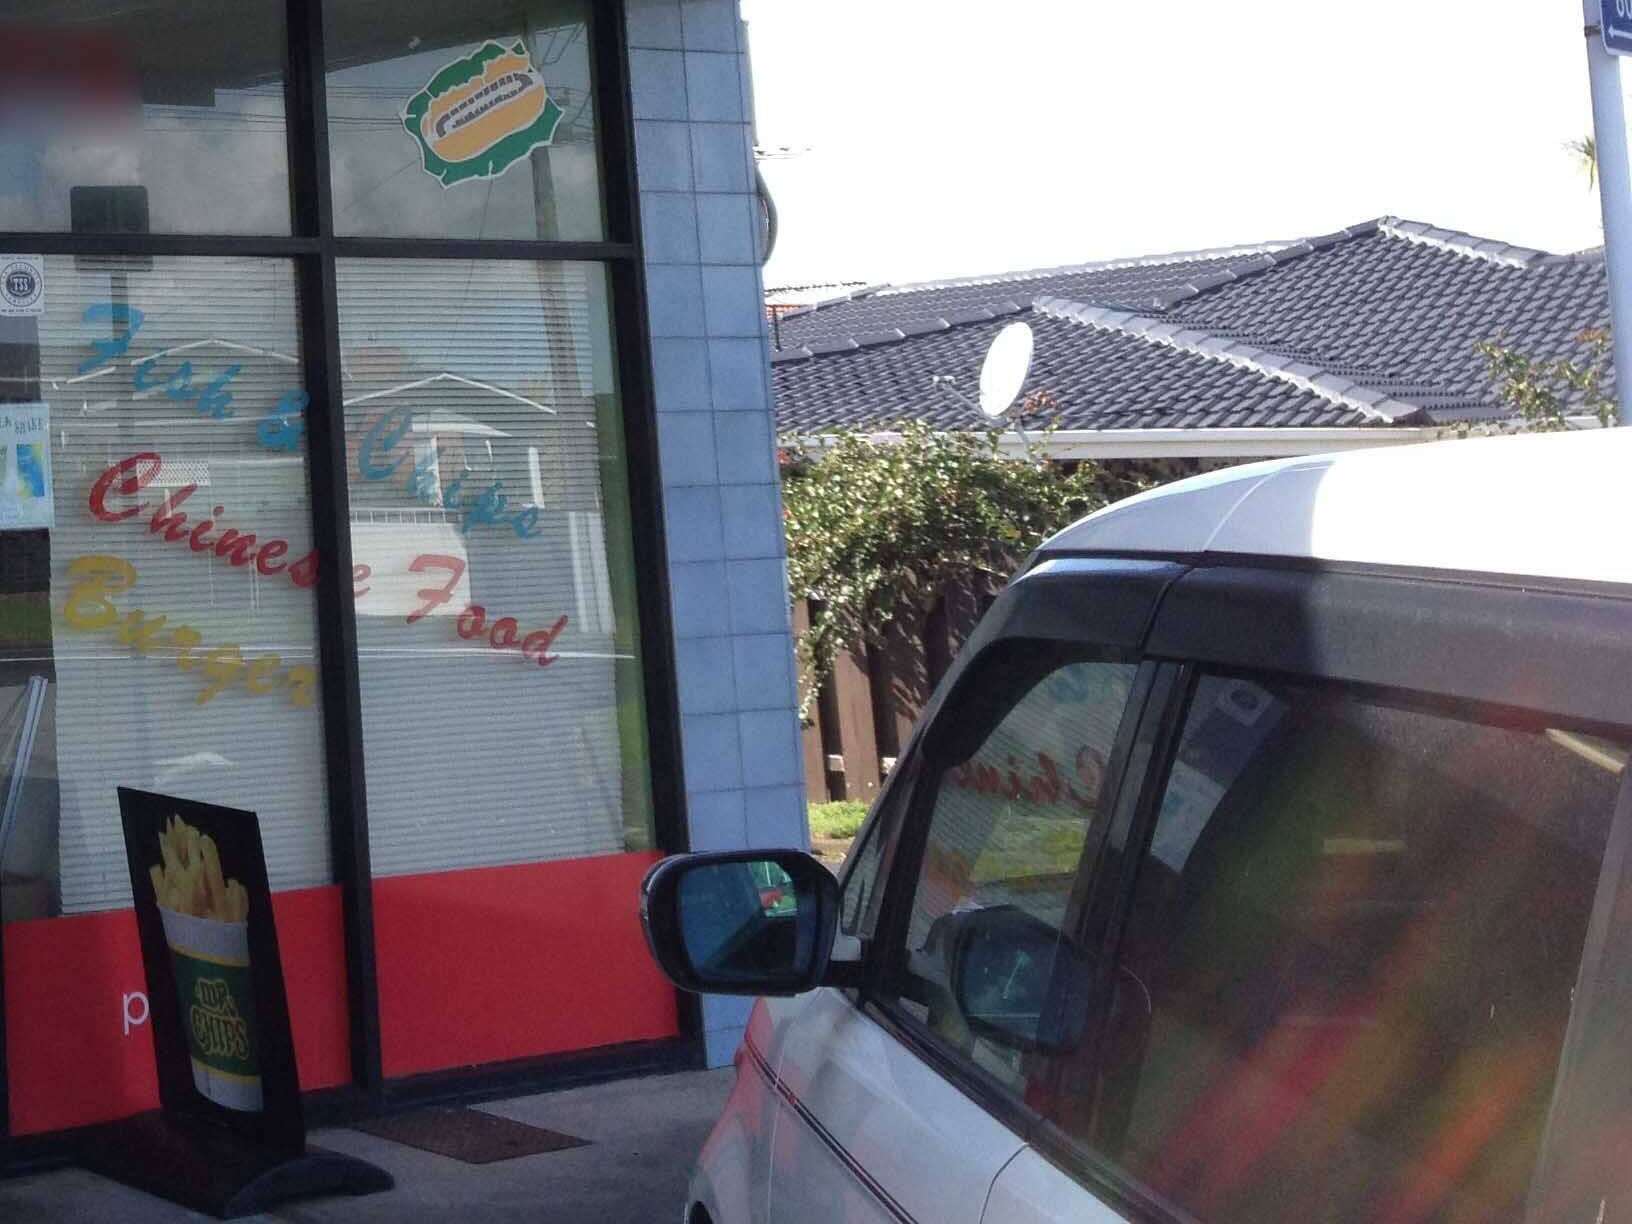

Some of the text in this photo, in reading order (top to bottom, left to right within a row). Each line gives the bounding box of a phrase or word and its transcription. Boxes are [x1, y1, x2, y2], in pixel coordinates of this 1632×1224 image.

[79, 301, 243, 420] Fish
[256, 389, 310, 452] &
[357, 404, 542, 539] Chips
[88, 451, 569, 666] Chinese Food
